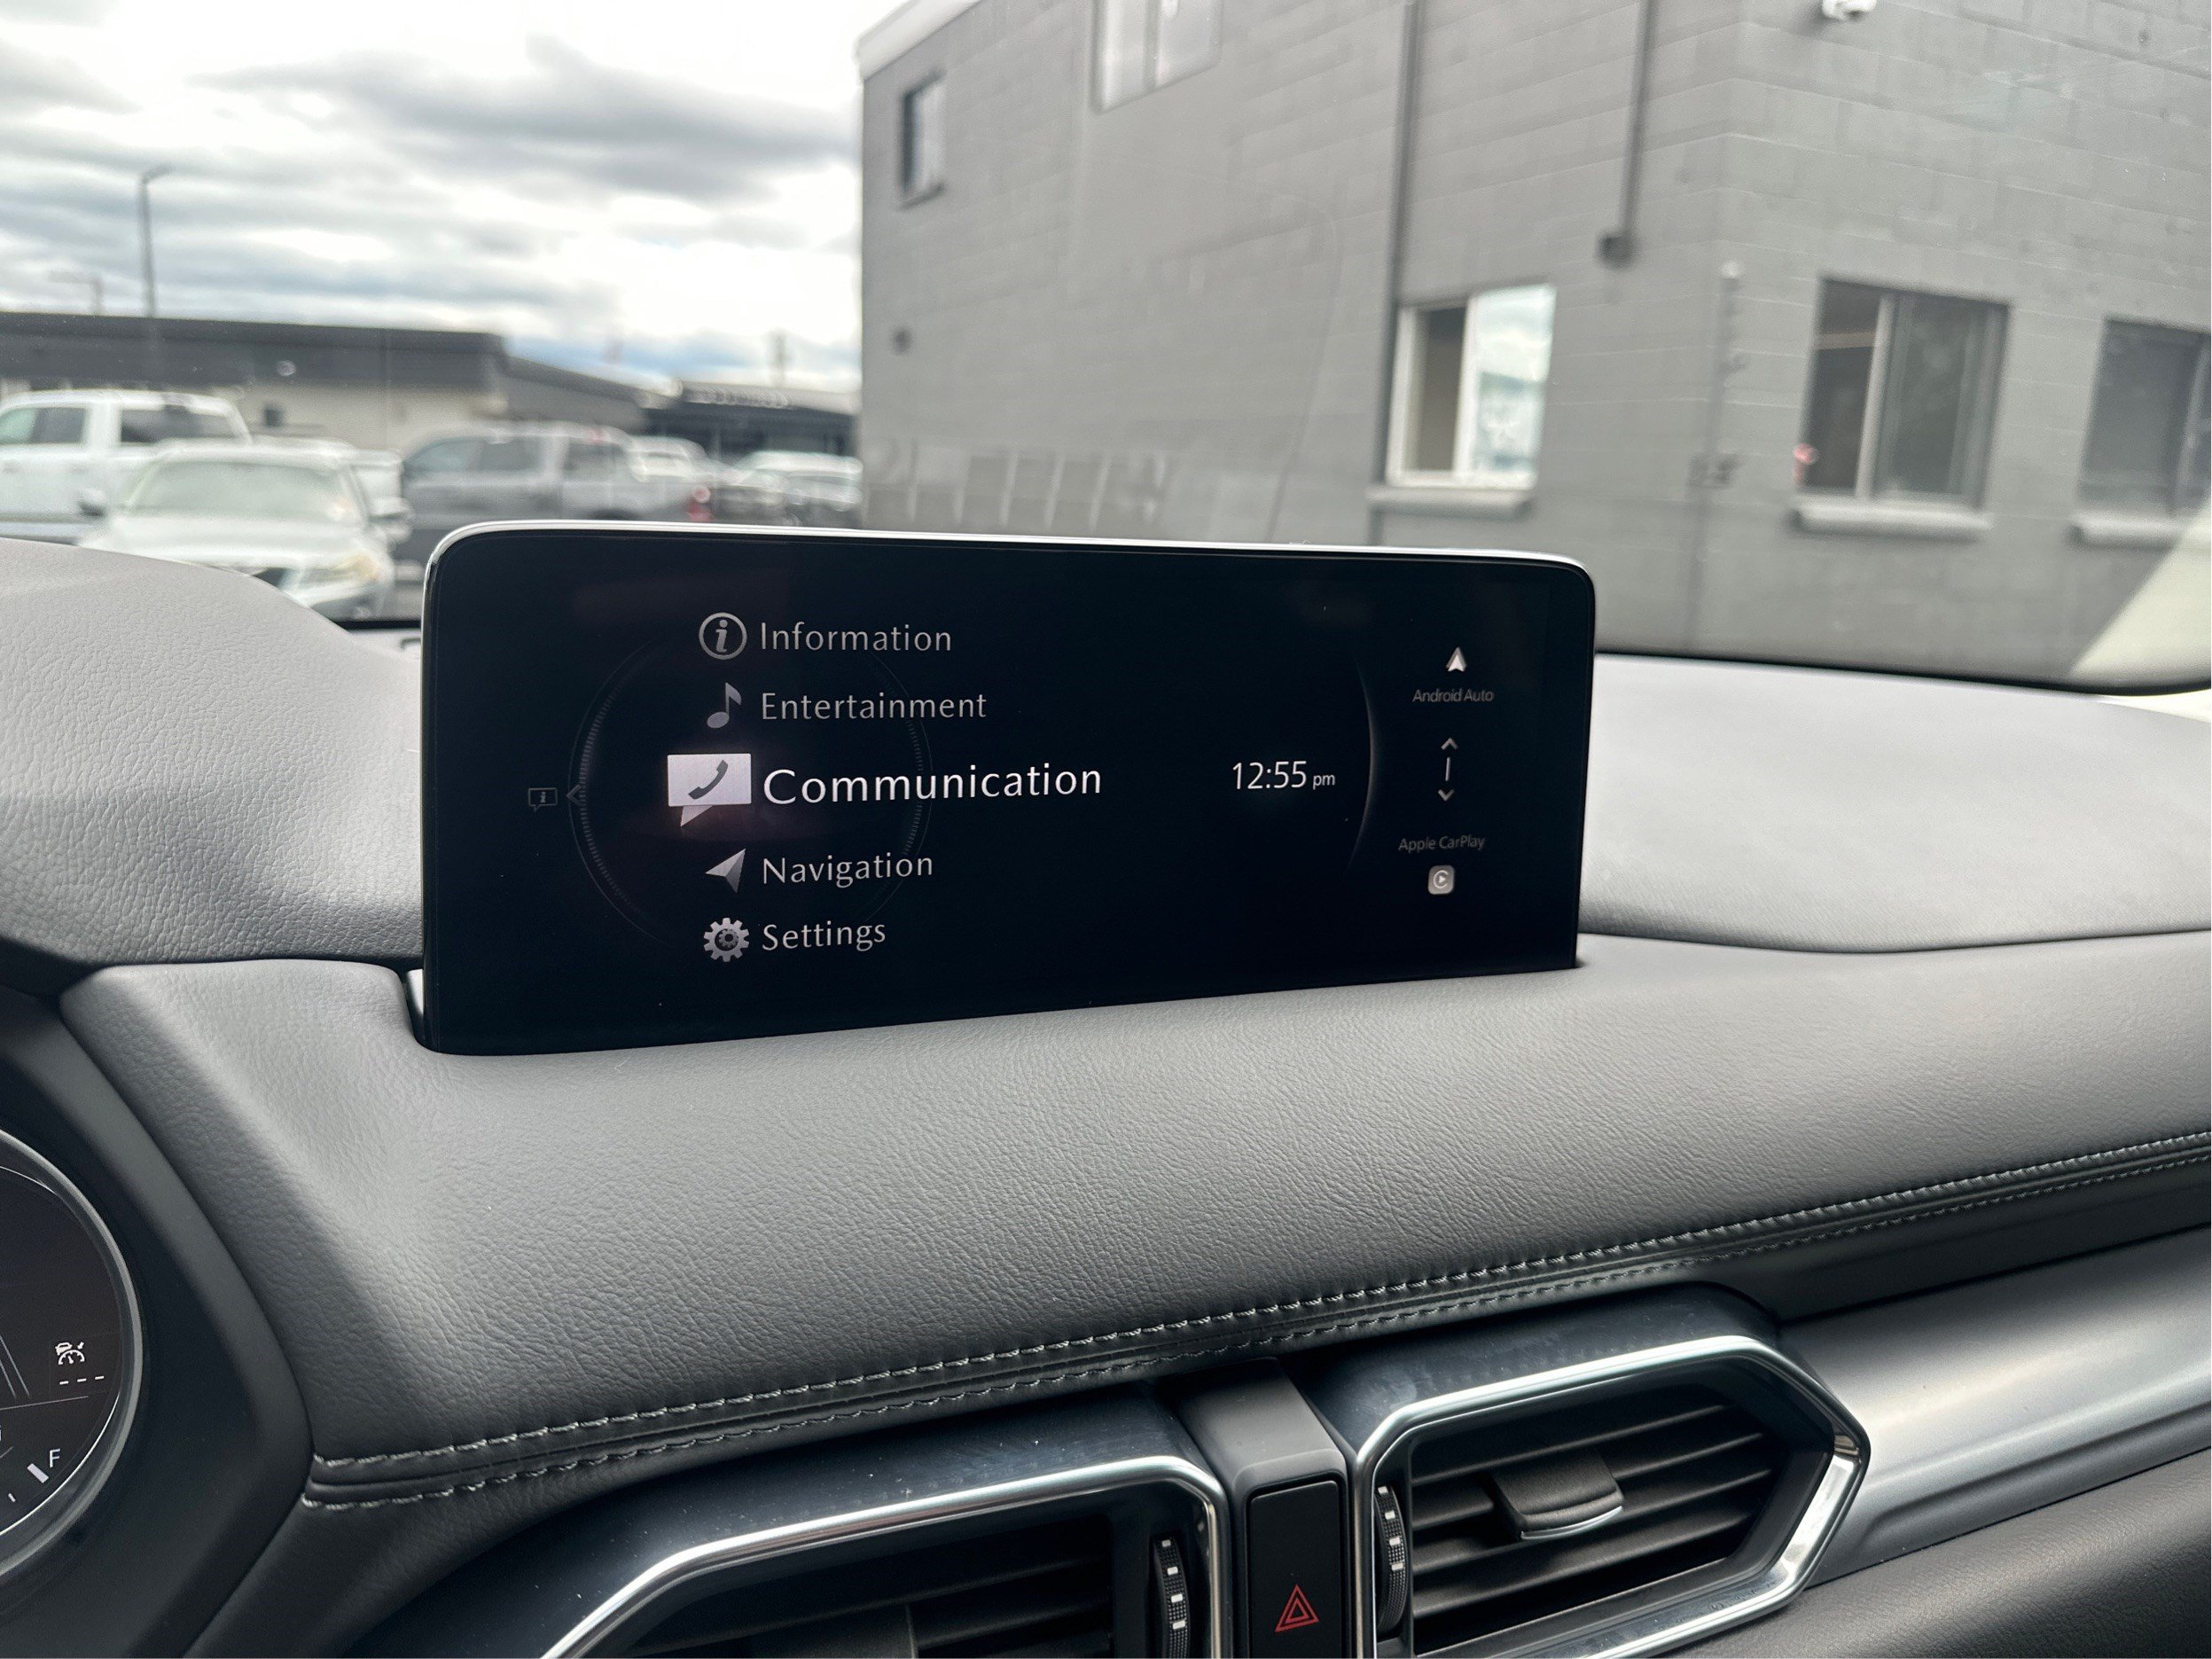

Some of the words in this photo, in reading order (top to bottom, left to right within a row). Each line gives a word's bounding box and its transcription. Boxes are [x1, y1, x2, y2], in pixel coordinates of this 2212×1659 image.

[761, 621, 952, 652] Information
[762, 692, 987, 720] Entertainment
[1412, 688, 1462, 703] Android
[1463, 689, 1495, 703] Auto
[763, 763, 1101, 804] Communication
[1232, 760, 1308, 790] 12:55
[1312, 773, 1336, 790] pm
[1398, 837, 1435, 853] Apple
[1438, 834, 1486, 851] CarPlay
[762, 852, 933, 888] Navigation
[762, 920, 886, 952] Settings
[49, 1448, 61, 1468] F
